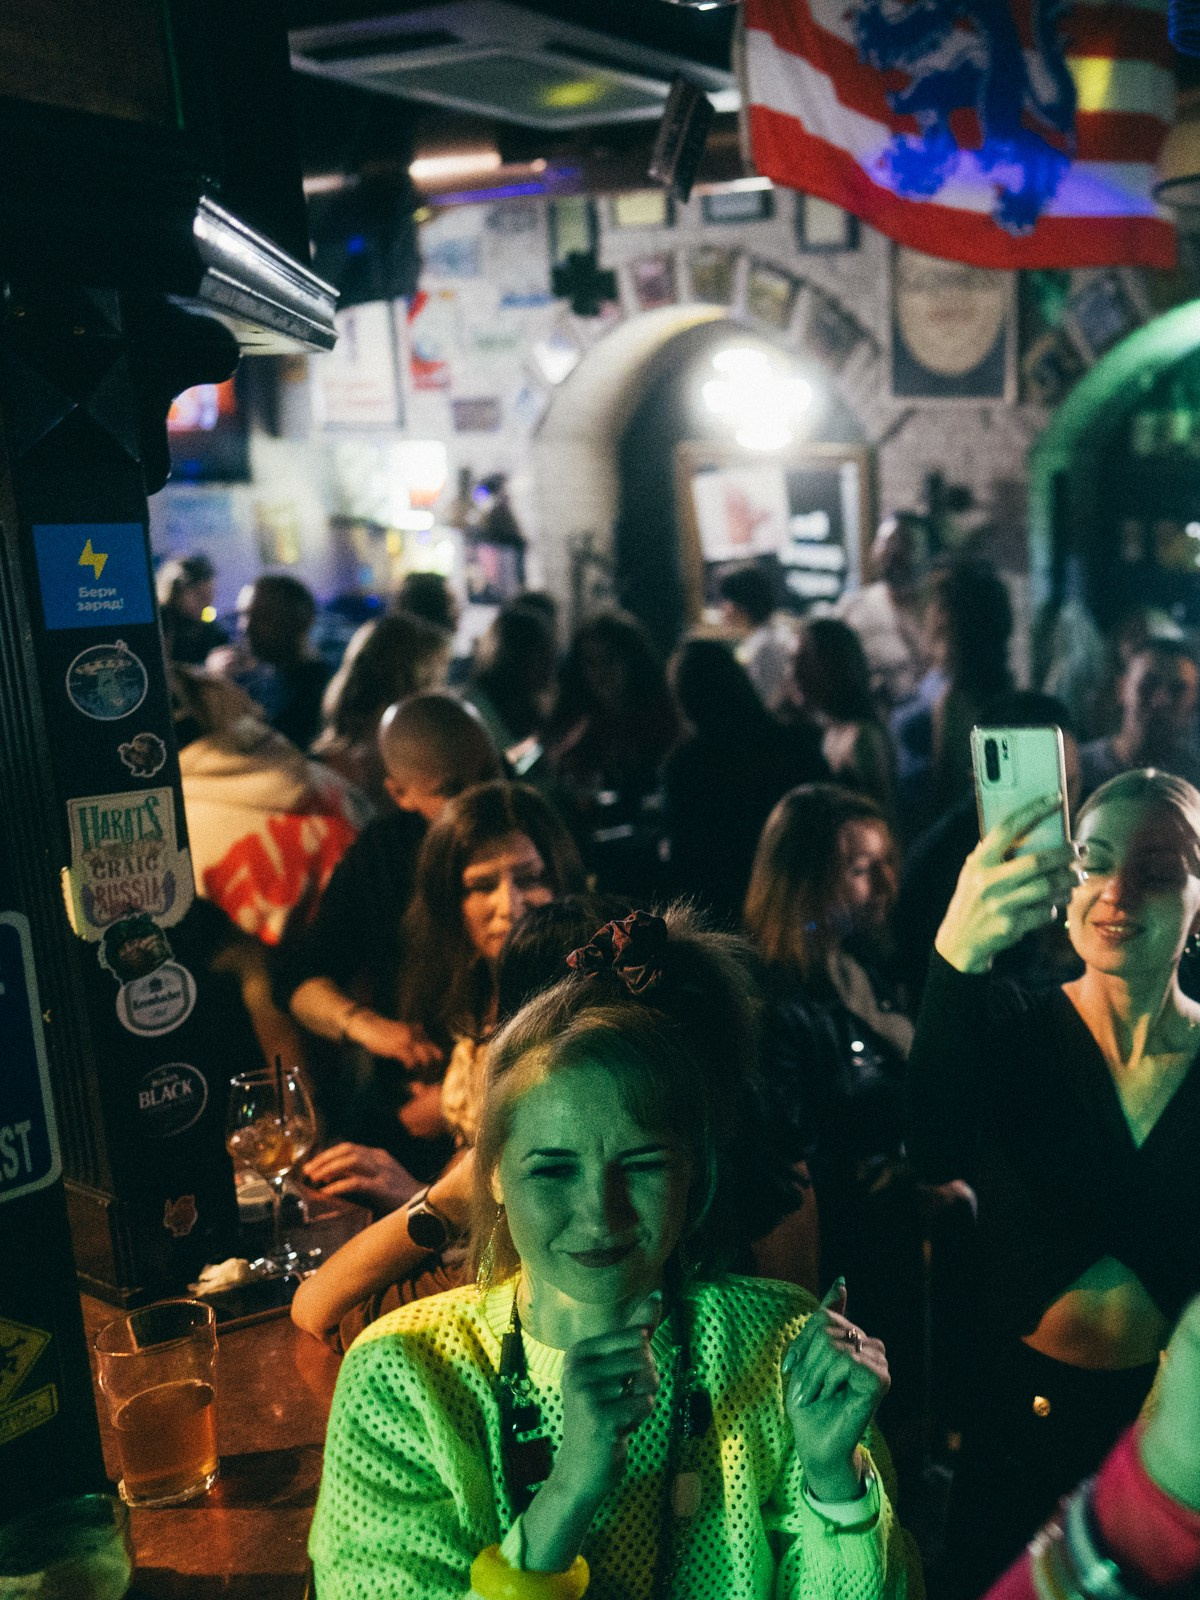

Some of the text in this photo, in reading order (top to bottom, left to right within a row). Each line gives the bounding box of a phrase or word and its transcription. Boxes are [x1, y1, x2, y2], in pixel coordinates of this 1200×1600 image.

[77, 598, 125, 612] заряд!
[78, 586, 117, 600] Бери
[79, 796, 163, 851] HARATS
[138, 1078, 192, 1110] BLACK
[0, 1119, 32, 1182] ST
